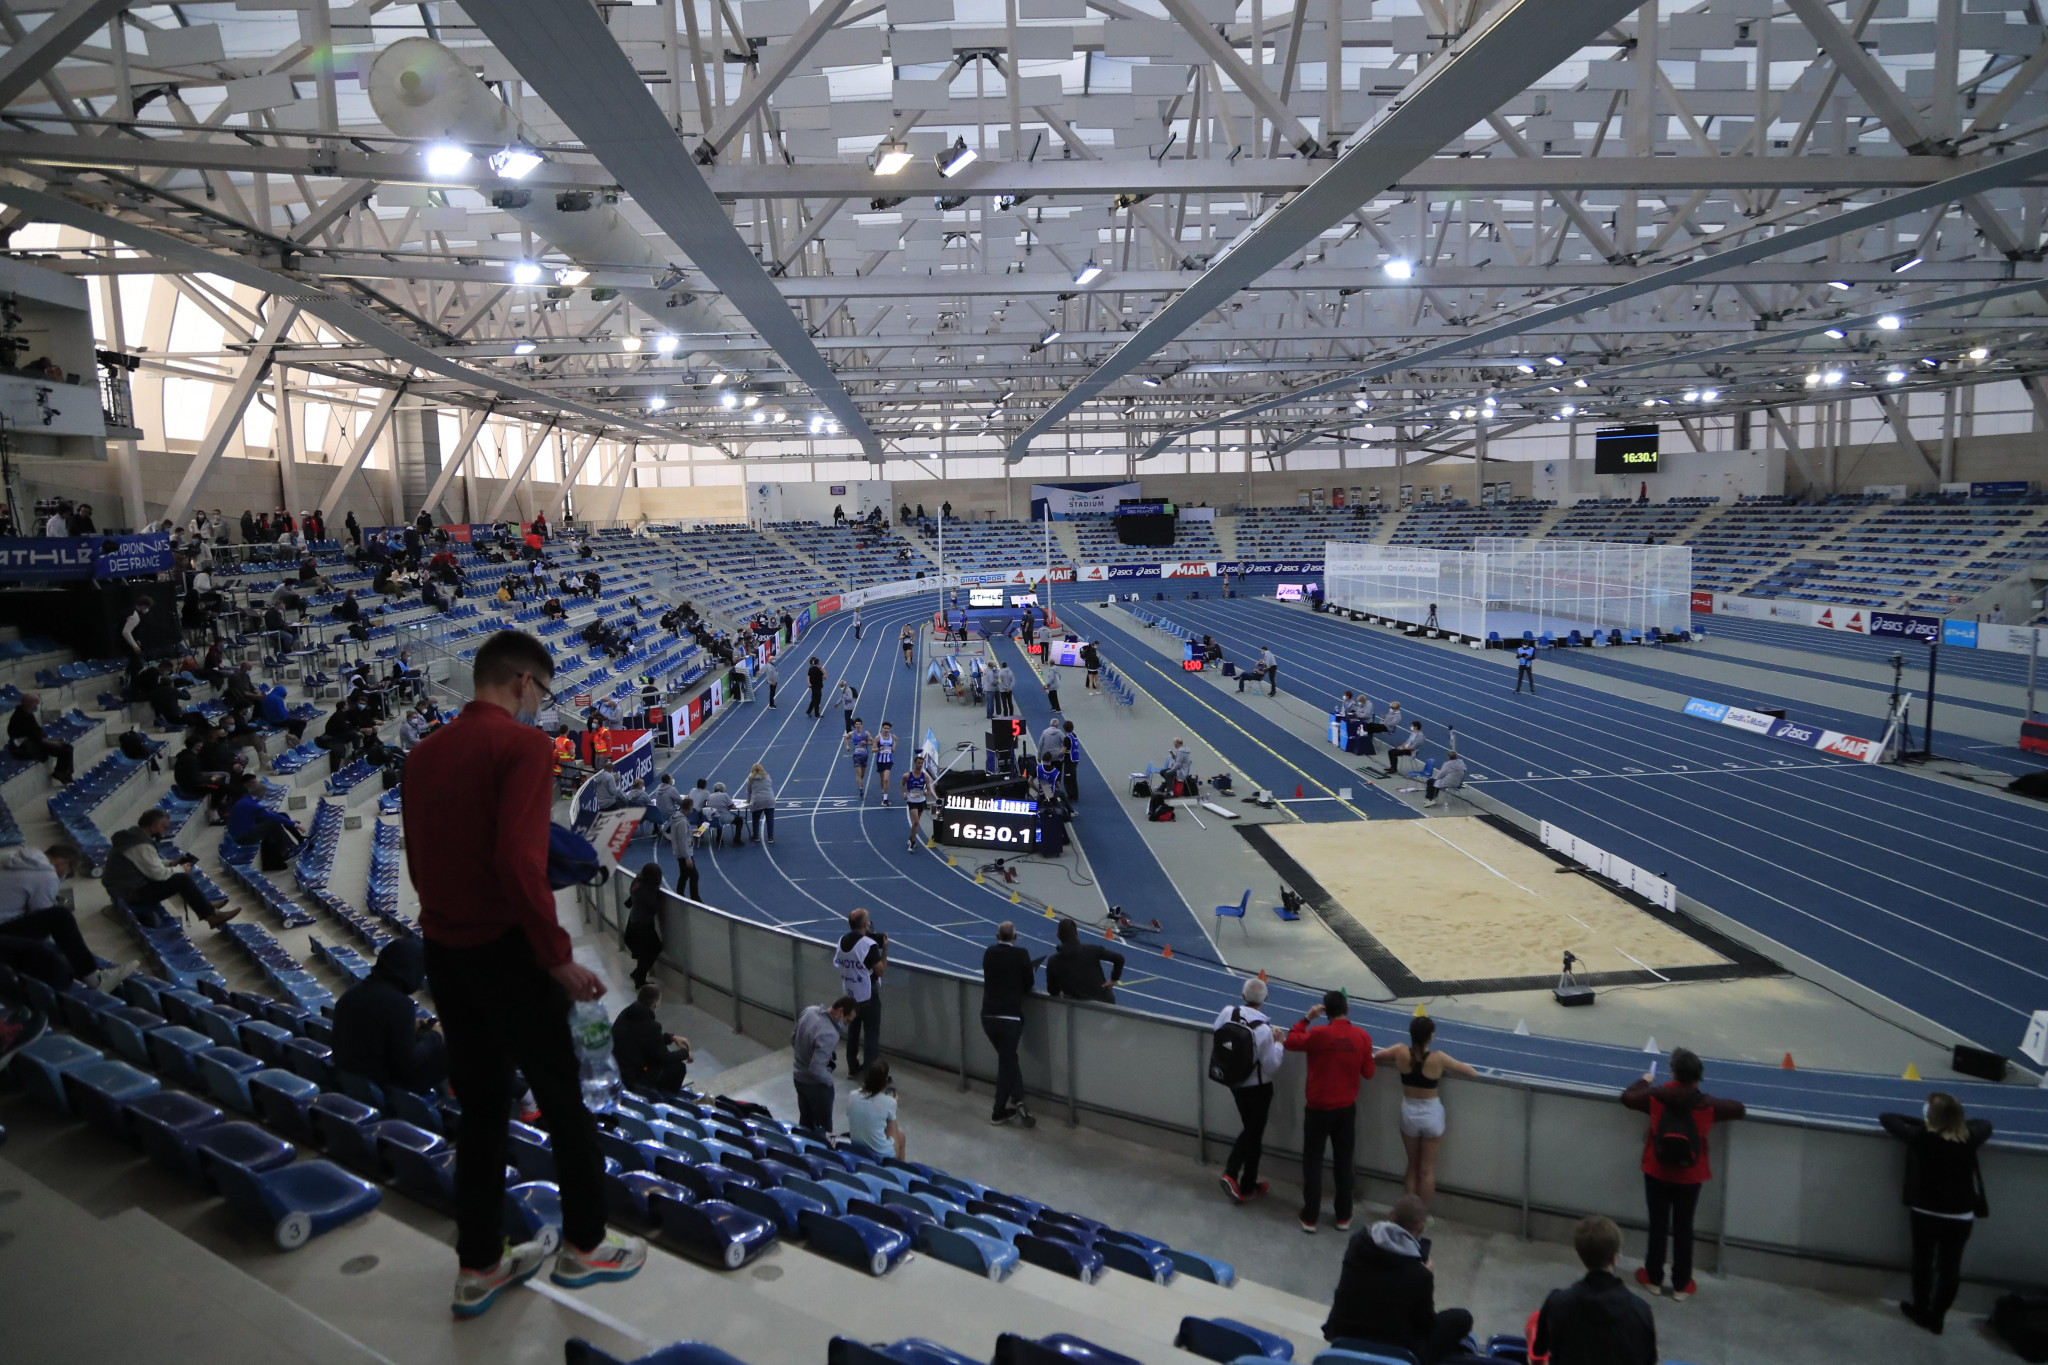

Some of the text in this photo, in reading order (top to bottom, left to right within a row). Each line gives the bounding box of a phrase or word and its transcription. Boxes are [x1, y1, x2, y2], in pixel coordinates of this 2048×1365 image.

[1622, 452, 1658, 463] 16:30.1
[130, 555, 161, 569] FRANCE
[1048, 569, 1073, 581] MAIF
[1176, 564, 1208, 576] MAIF
[960, 574, 1006, 584] DIMASPORT
[970, 592, 1003, 600] ATHLÉ
[1882, 620, 1938, 635] asics asics
[1027, 645, 1042, 654] 1:00
[1183, 660, 1202, 671] 1:00
[1011, 719, 1021, 737] 5
[1788, 726, 1812, 741] asics
[1834, 738, 1868, 756] MAIF
[949, 823, 1031, 844] 16:30.1
